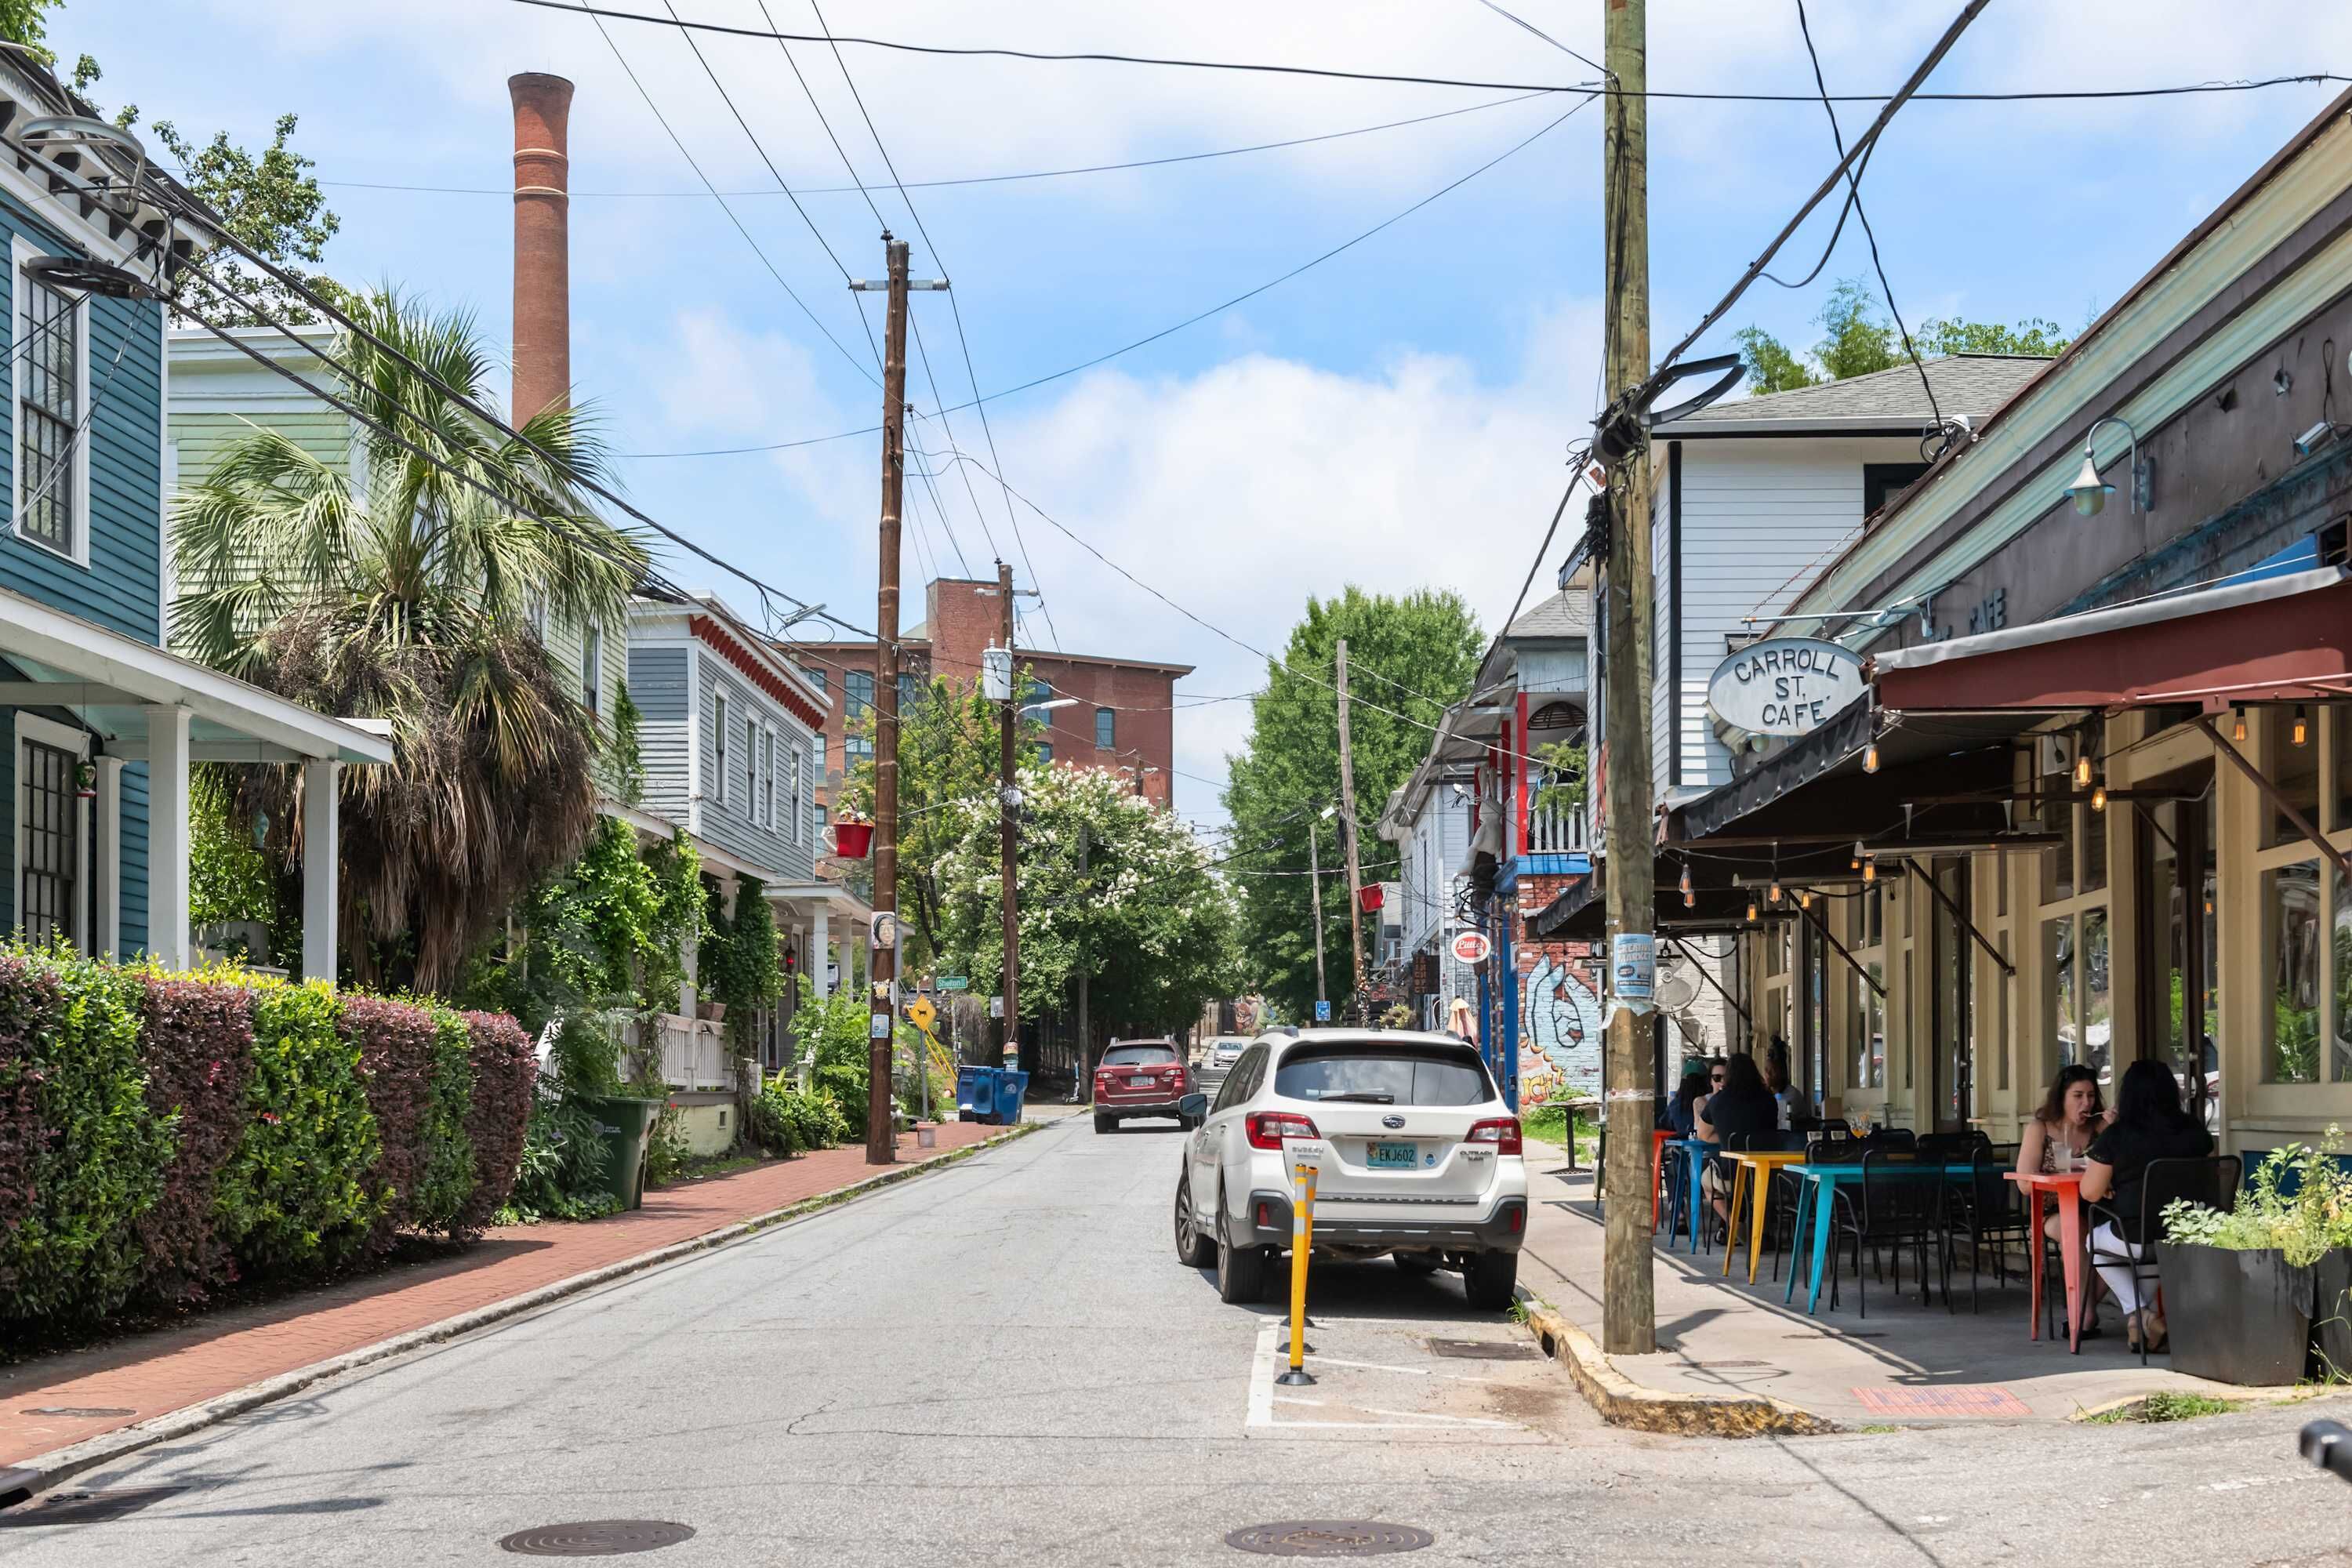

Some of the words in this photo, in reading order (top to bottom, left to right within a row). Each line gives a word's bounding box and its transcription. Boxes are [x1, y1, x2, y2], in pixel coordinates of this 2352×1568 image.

[1734, 648, 1840, 682] CARROLL
[1775, 676, 1806, 700] ST.
[1379, 1148, 1414, 1162] EKJ602
